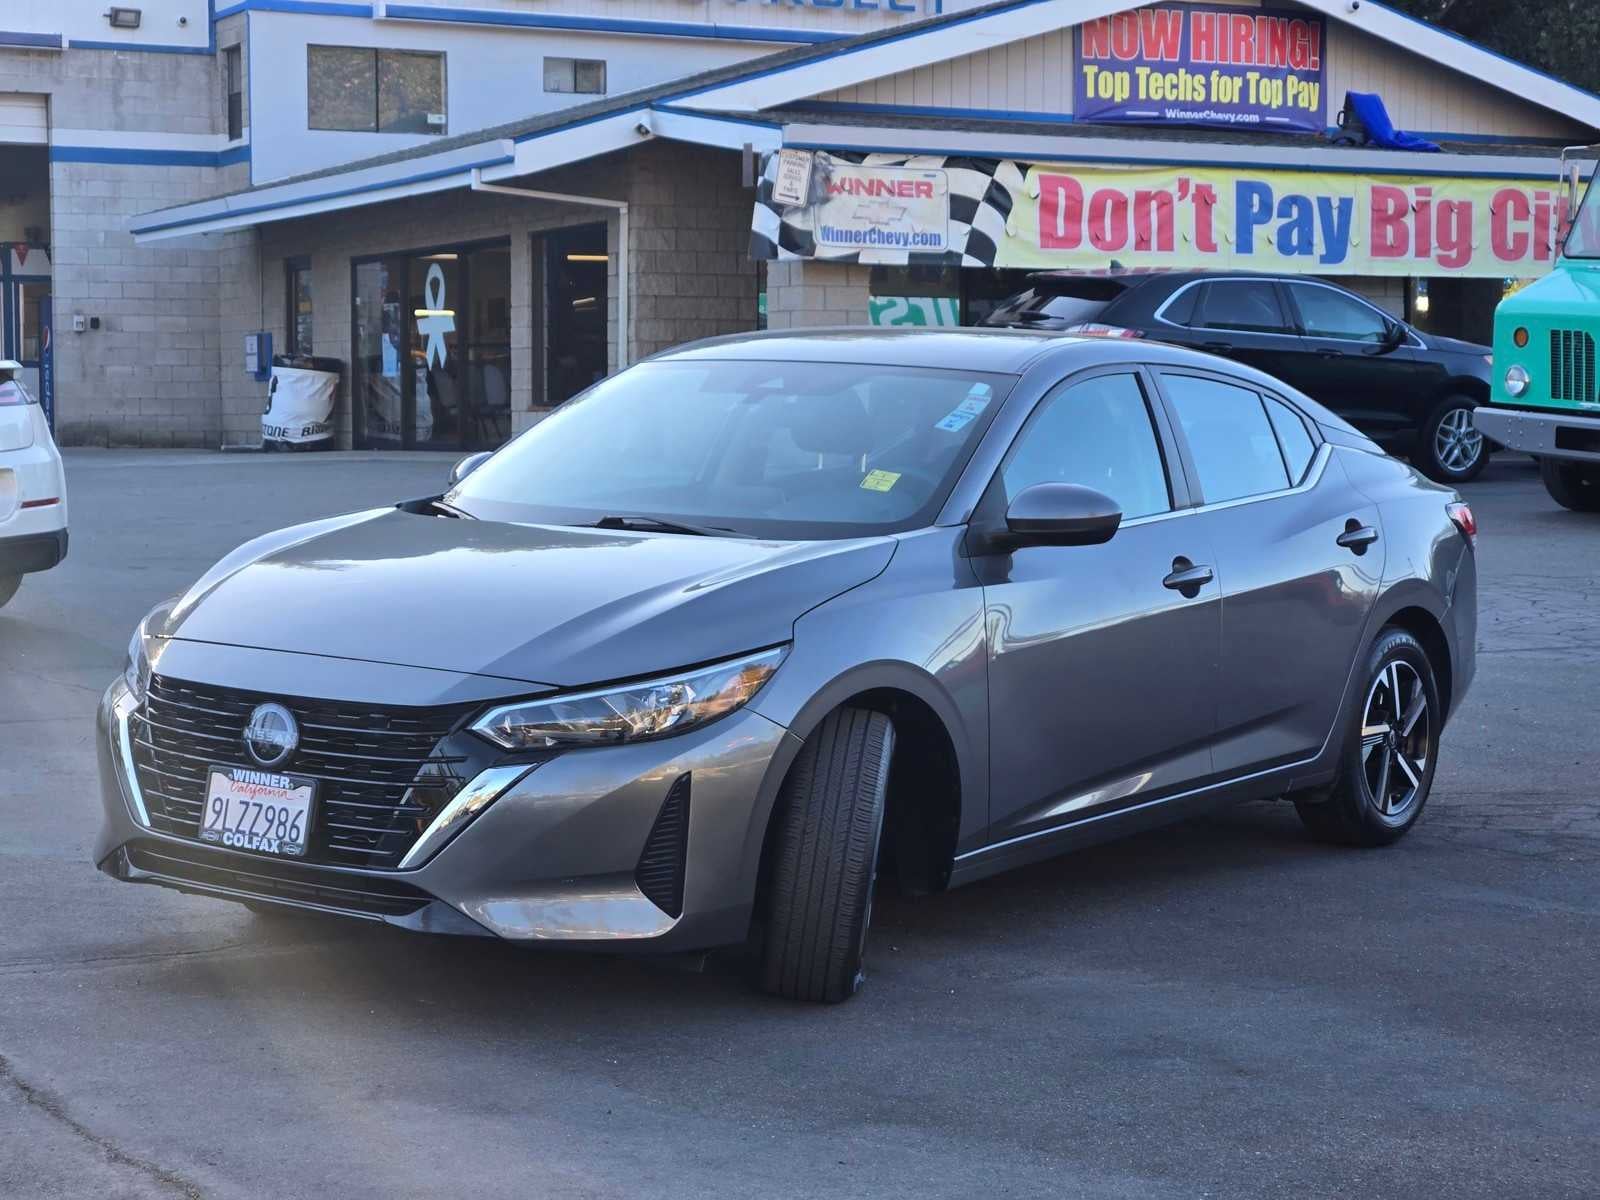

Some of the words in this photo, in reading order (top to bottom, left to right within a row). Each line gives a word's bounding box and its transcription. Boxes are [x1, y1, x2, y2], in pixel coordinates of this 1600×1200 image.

[1082, 9, 1184, 61] NOW
[1190, 11, 1320, 71] HIRING!
[1083, 65, 1130, 103] Top
[1135, 66, 1206, 102] Techs
[1210, 69, 1243, 104] for
[1246, 71, 1285, 109] Top
[1287, 74, 1320, 112] Pay
[1165, 104, 1260, 122] WinnerChevy.com
[824, 176, 934, 199] WINNER
[1038, 173, 1219, 253] Don't
[1235, 180, 1353, 264] Pay
[1370, 186, 1473, 268] Big
[820, 225, 942, 247] WinnerChevy.com
[244, 726, 298, 750] NISSAN
[232, 769, 290, 789] WINNER
[230, 781, 294, 800] California
[222, 832, 280, 854] COLFAX
